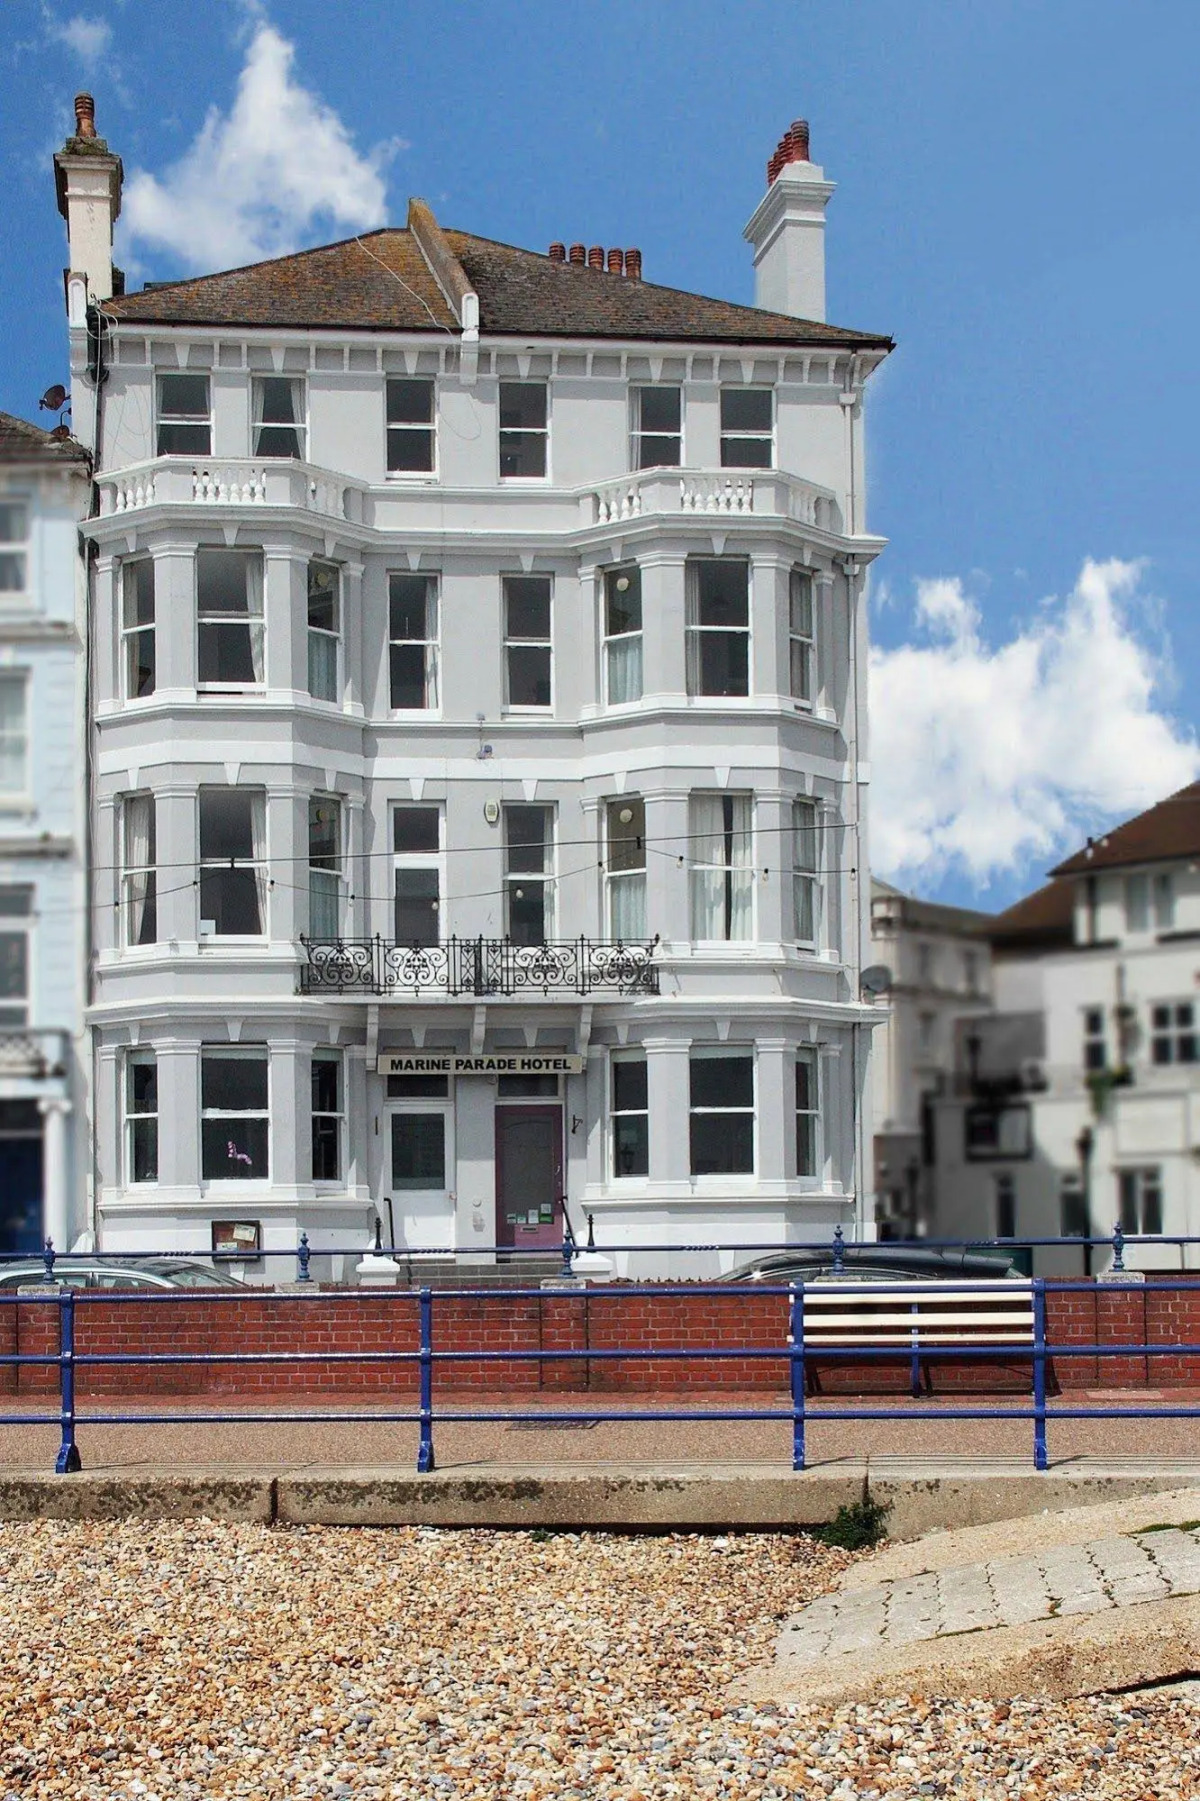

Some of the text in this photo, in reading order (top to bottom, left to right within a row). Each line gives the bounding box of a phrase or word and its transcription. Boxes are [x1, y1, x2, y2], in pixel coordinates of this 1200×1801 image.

[390, 1058, 571, 1070] MARINE PARADE HOTEL
